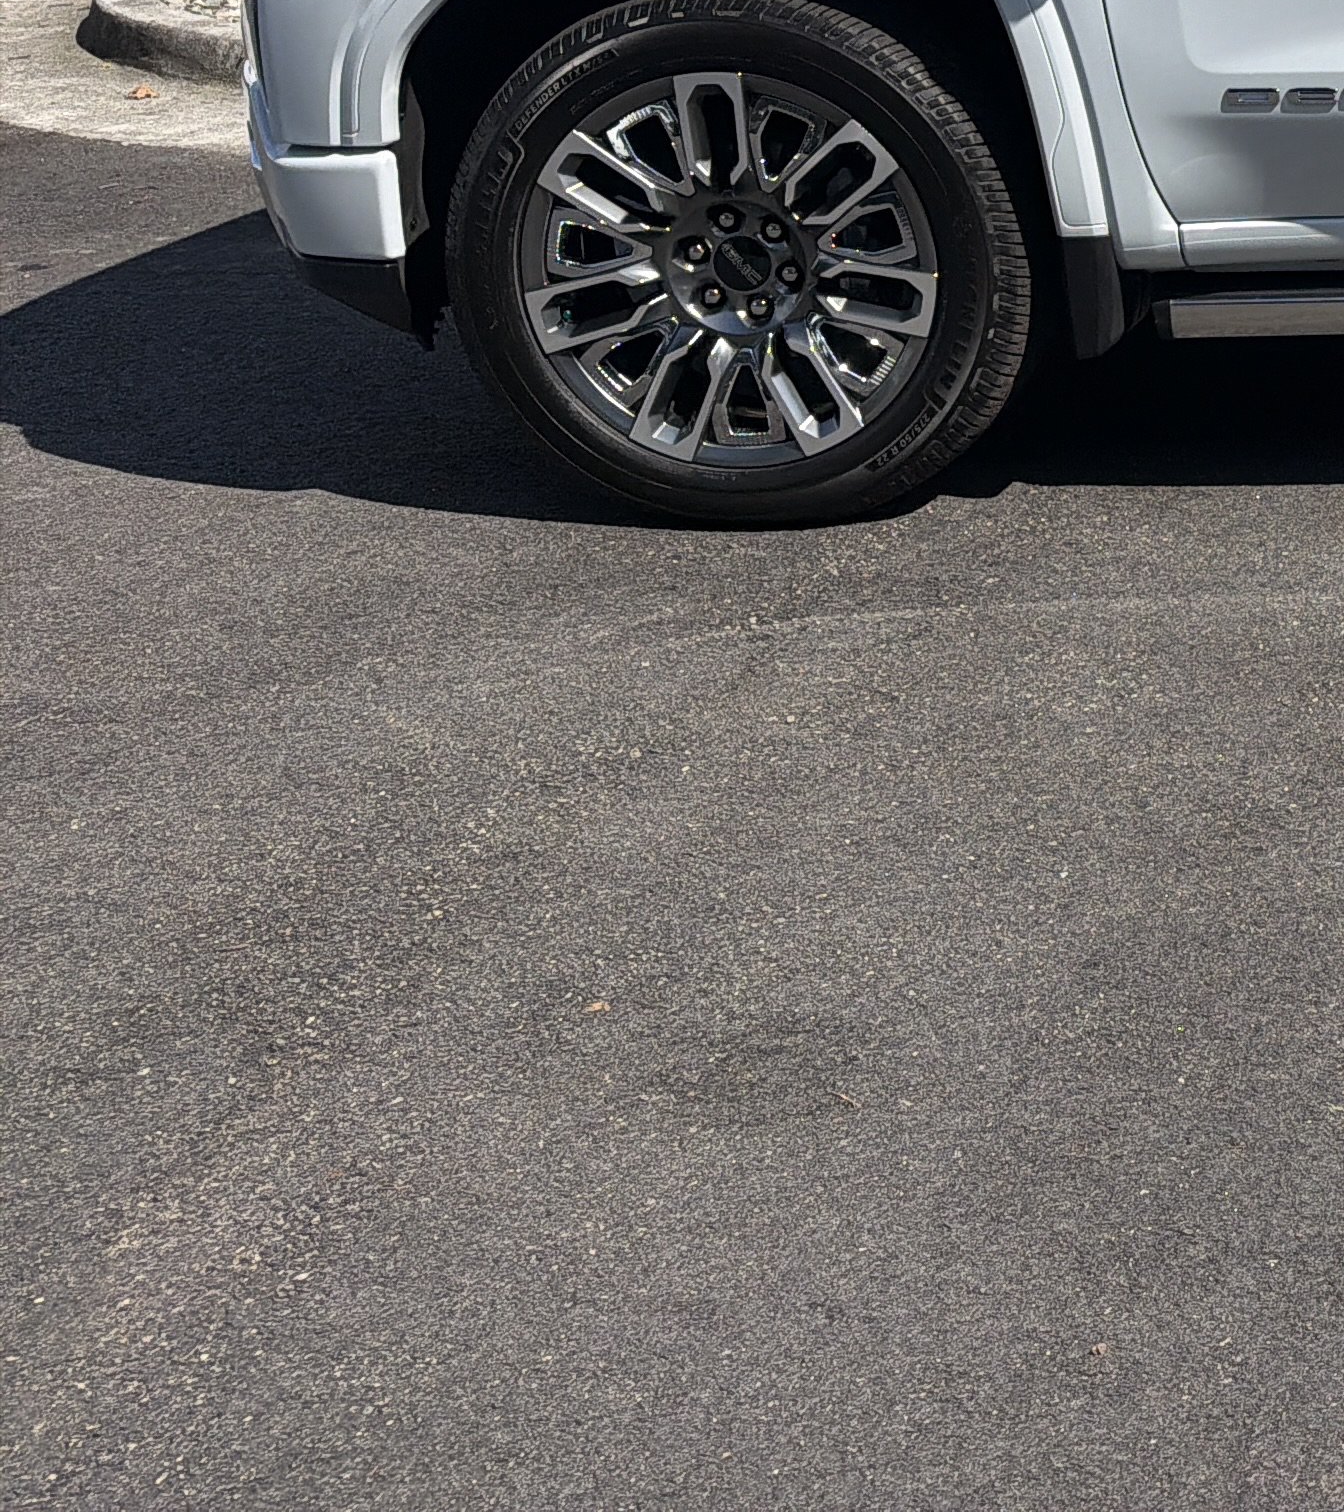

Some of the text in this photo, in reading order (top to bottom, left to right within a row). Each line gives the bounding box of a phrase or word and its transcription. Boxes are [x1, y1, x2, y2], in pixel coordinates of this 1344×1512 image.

[514, 83, 561, 131] DEFENDER
[560, 68, 583, 85] LTX
[721, 243, 763, 286] GMC
[877, 412, 931, 467] 275/50 R 22
